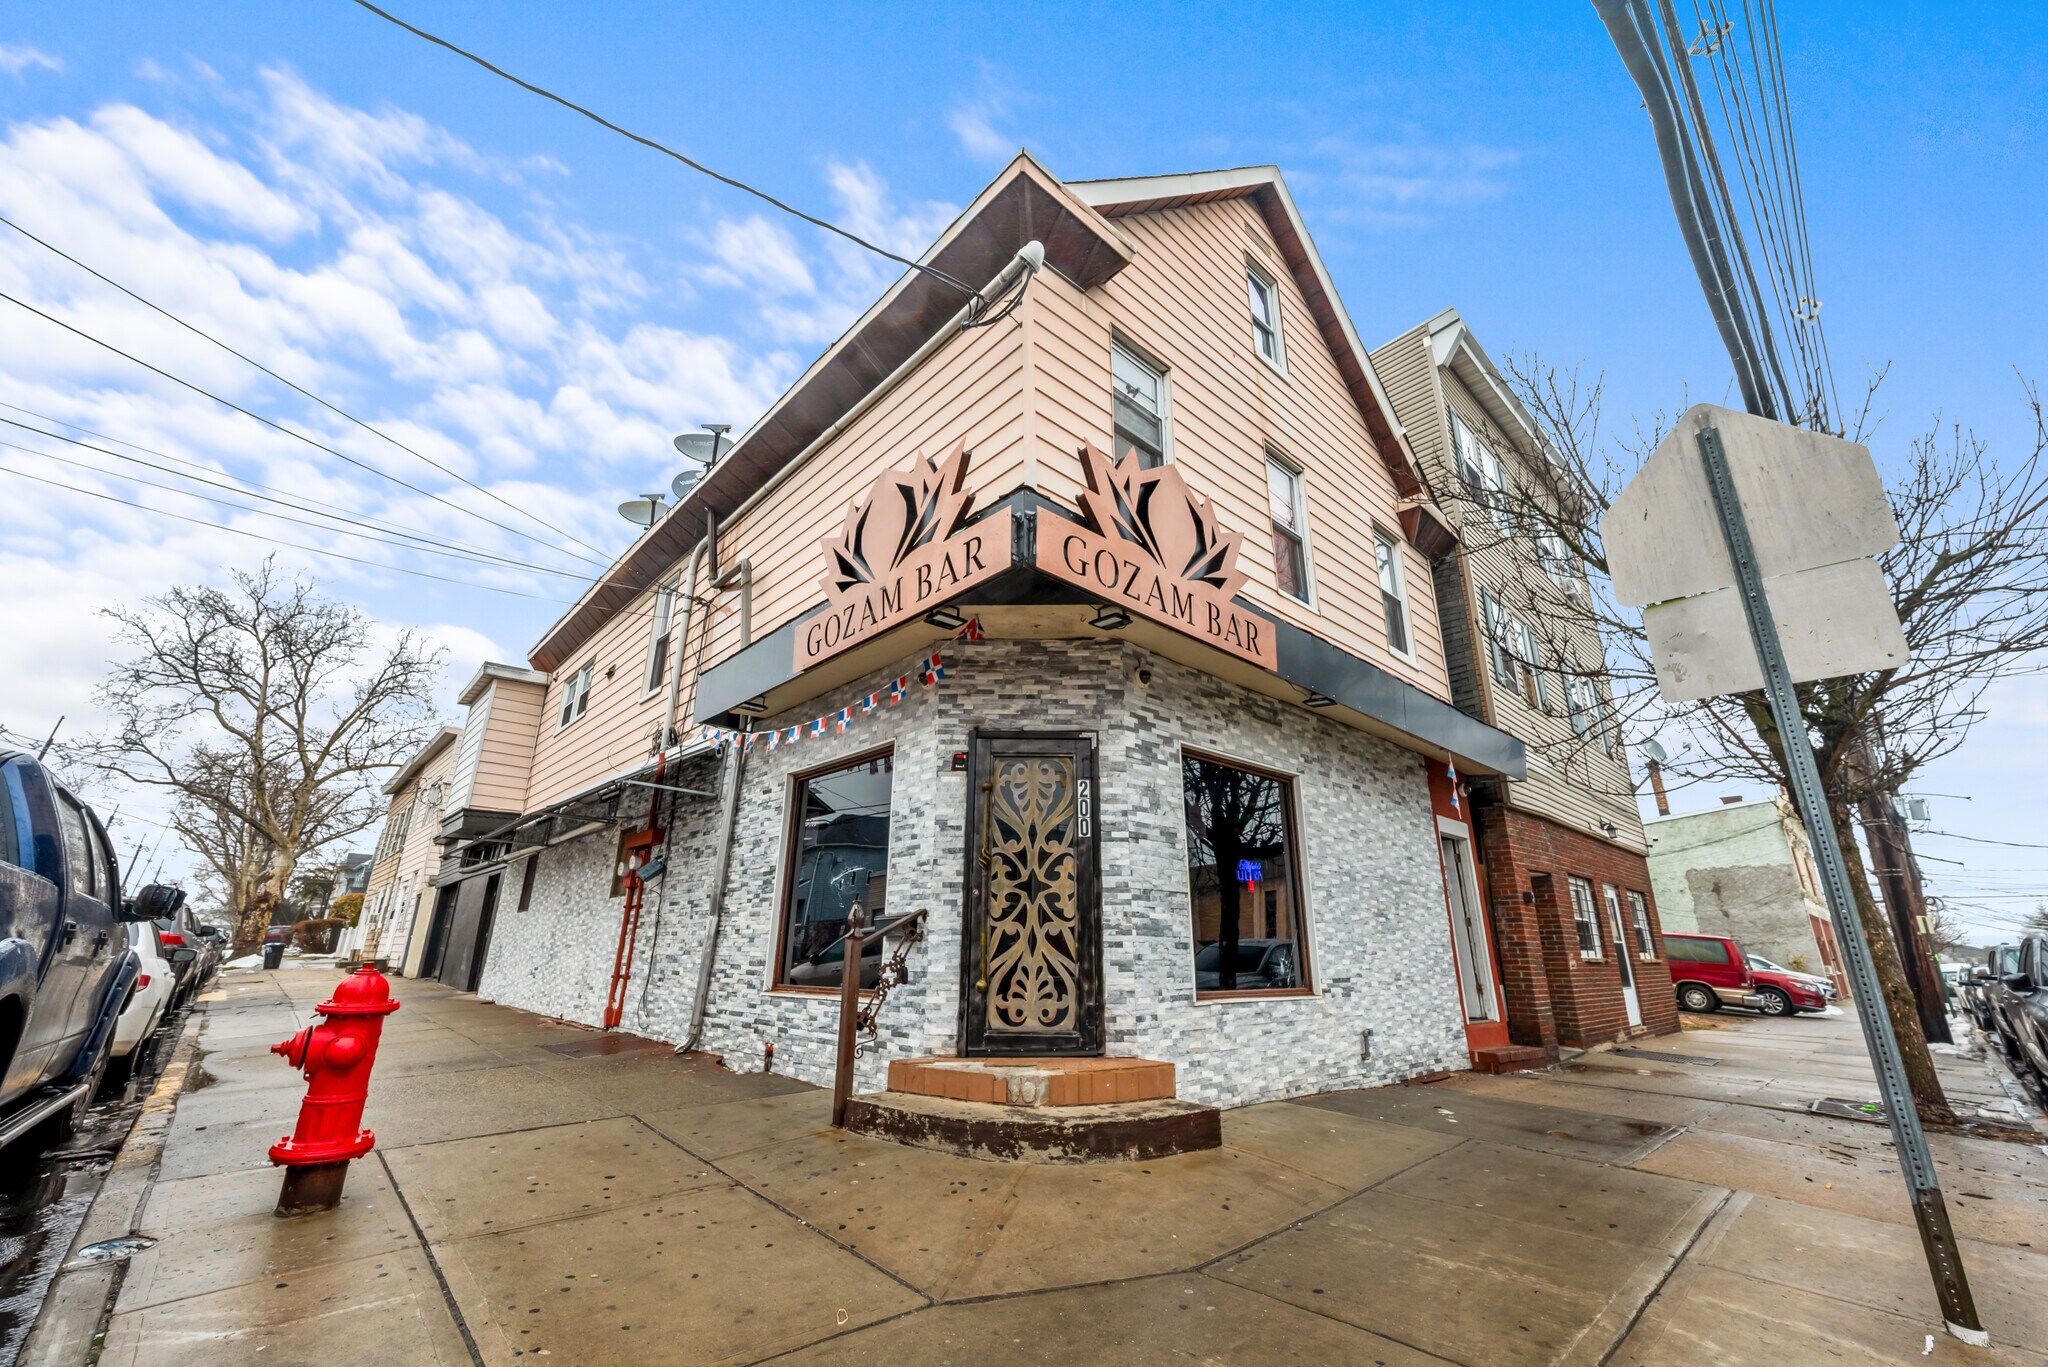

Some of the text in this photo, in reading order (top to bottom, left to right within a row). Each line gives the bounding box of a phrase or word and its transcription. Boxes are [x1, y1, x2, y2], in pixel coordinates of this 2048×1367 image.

[807, 536, 986, 657] GOZAM BAR
[1063, 535, 1262, 657] GOZAM BAR
[1079, 781, 1089, 836] 200
